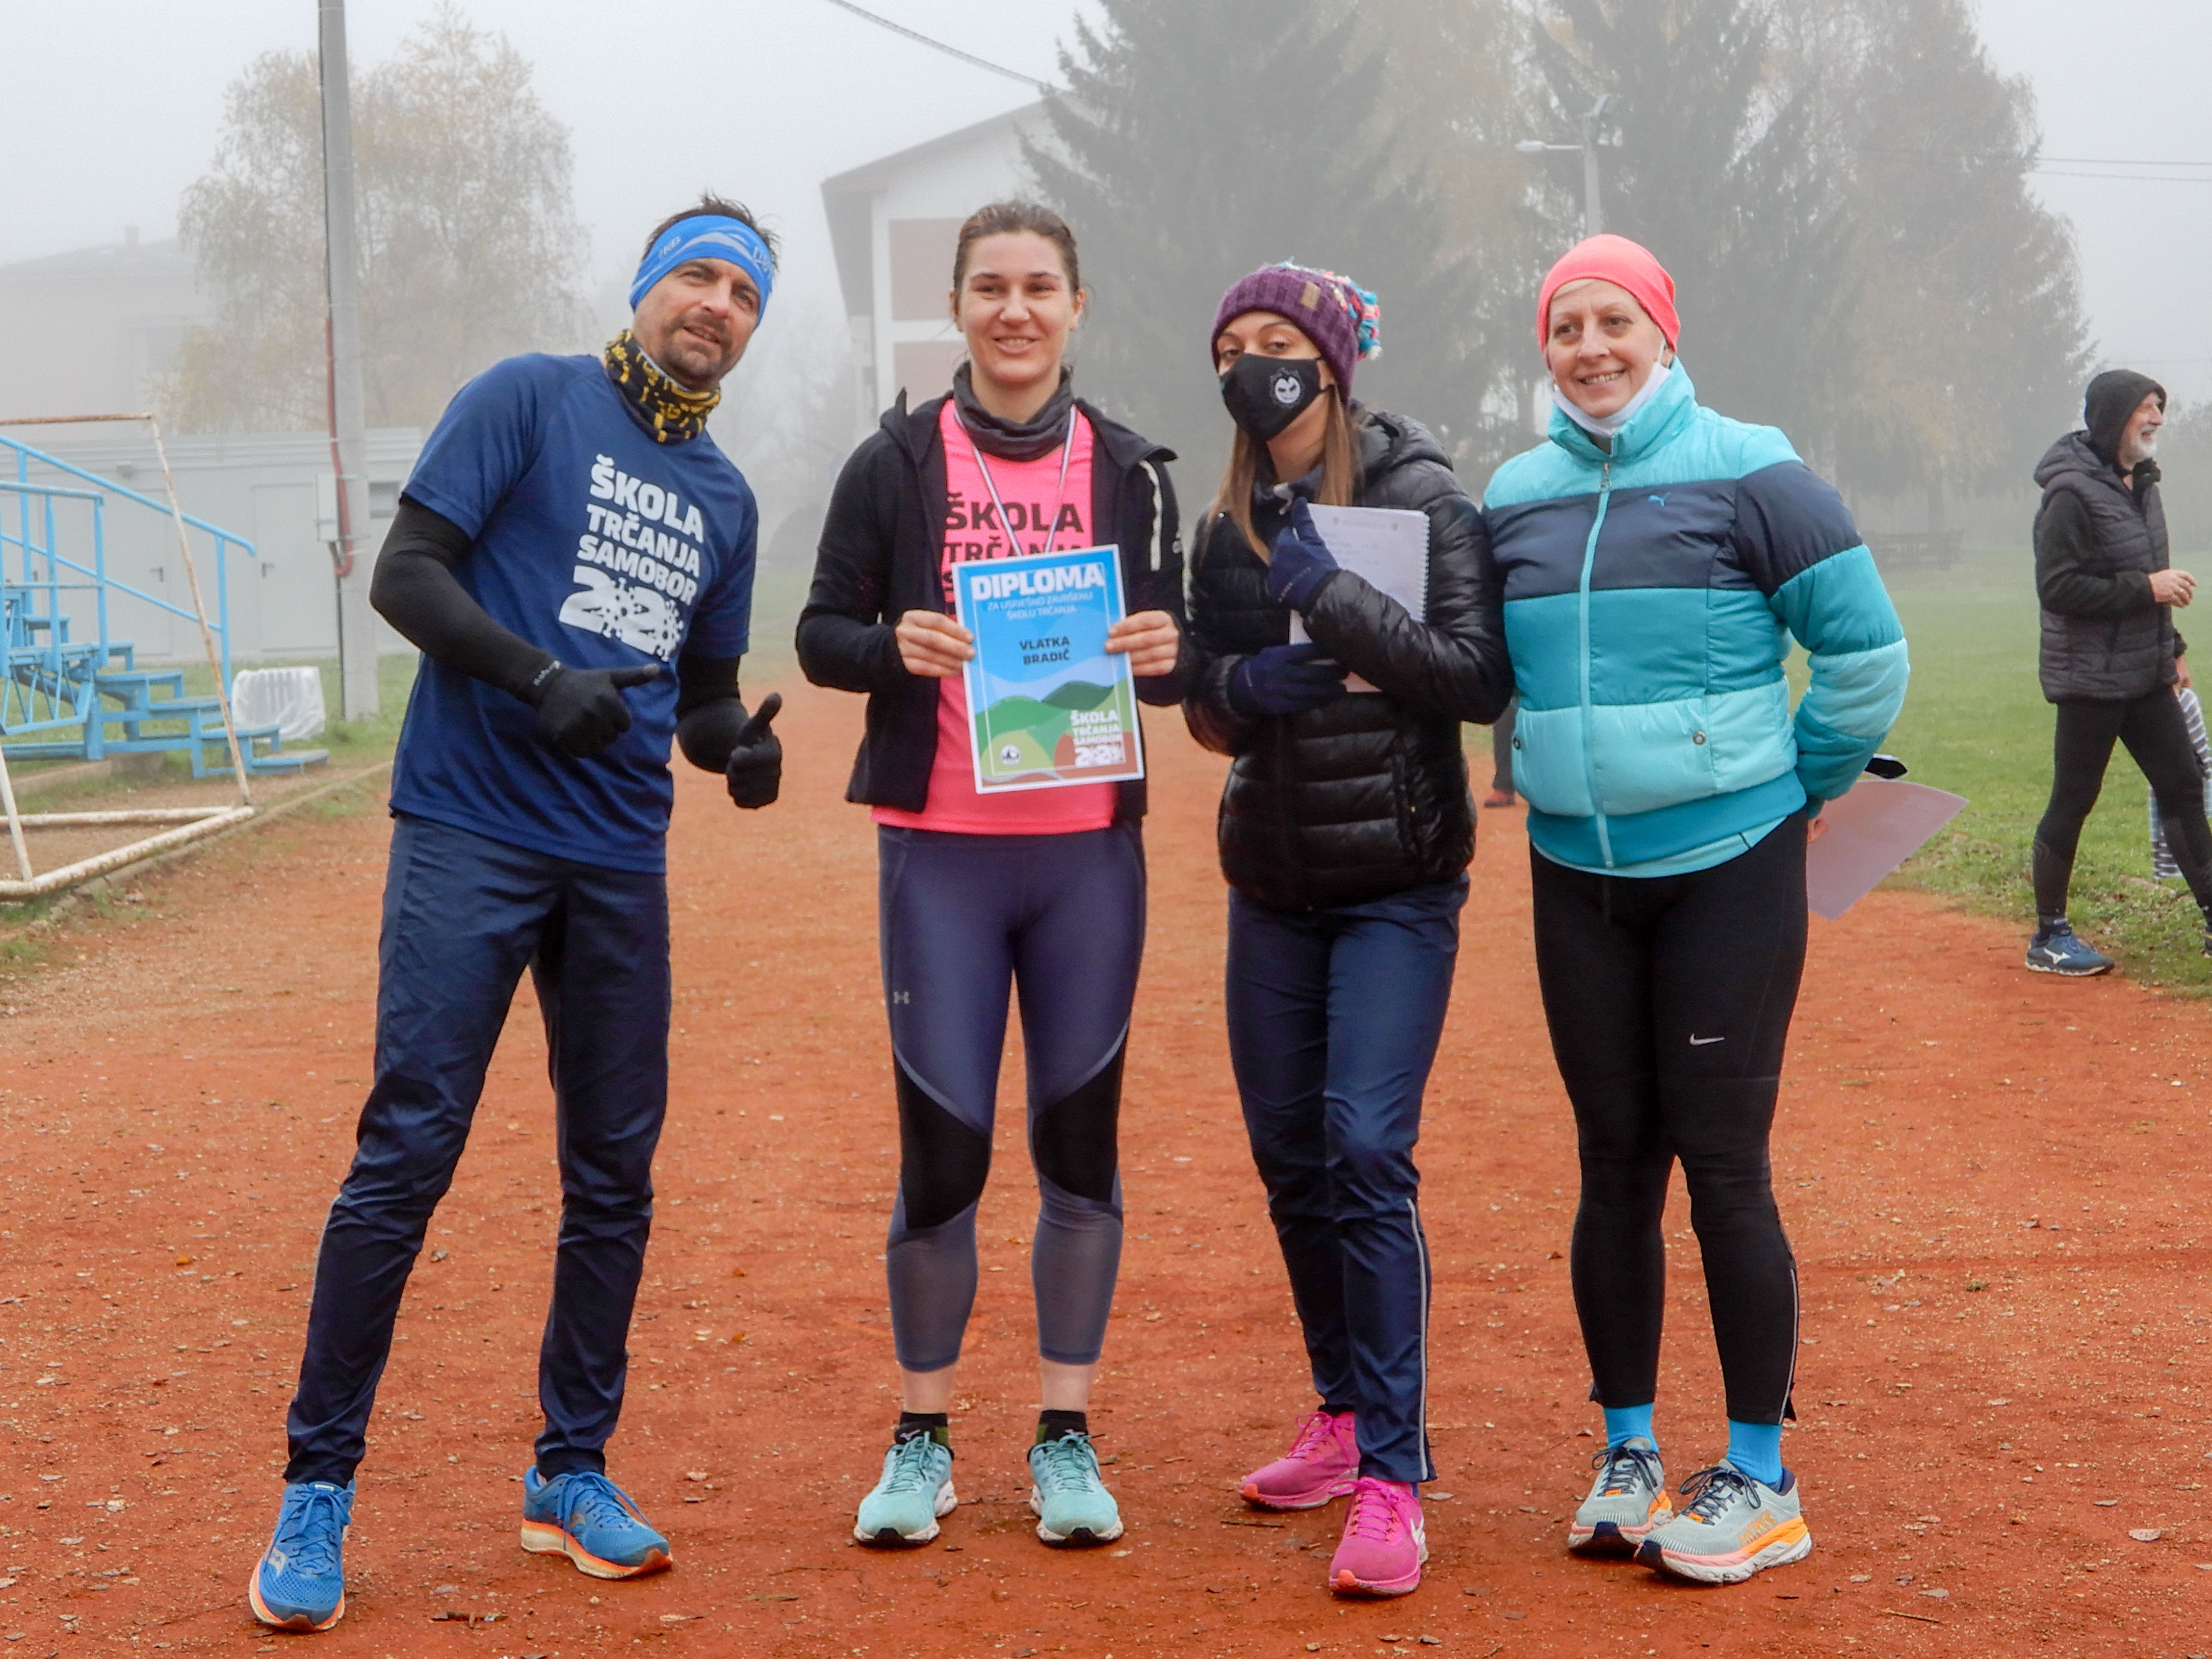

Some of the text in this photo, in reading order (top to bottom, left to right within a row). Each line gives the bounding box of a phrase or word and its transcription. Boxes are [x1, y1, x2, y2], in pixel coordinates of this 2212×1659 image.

[589, 453, 705, 544] ŠKOLA
[946, 492, 1084, 533] ŠKOLA
[586, 503, 700, 578] TRČANJA
[577, 533, 698, 606] SAMOBOR
[970, 562, 1105, 601] DIPLOMA
[1020, 636, 1070, 650] VLATKA
[1071, 709, 1118, 725] ŠKOLA
